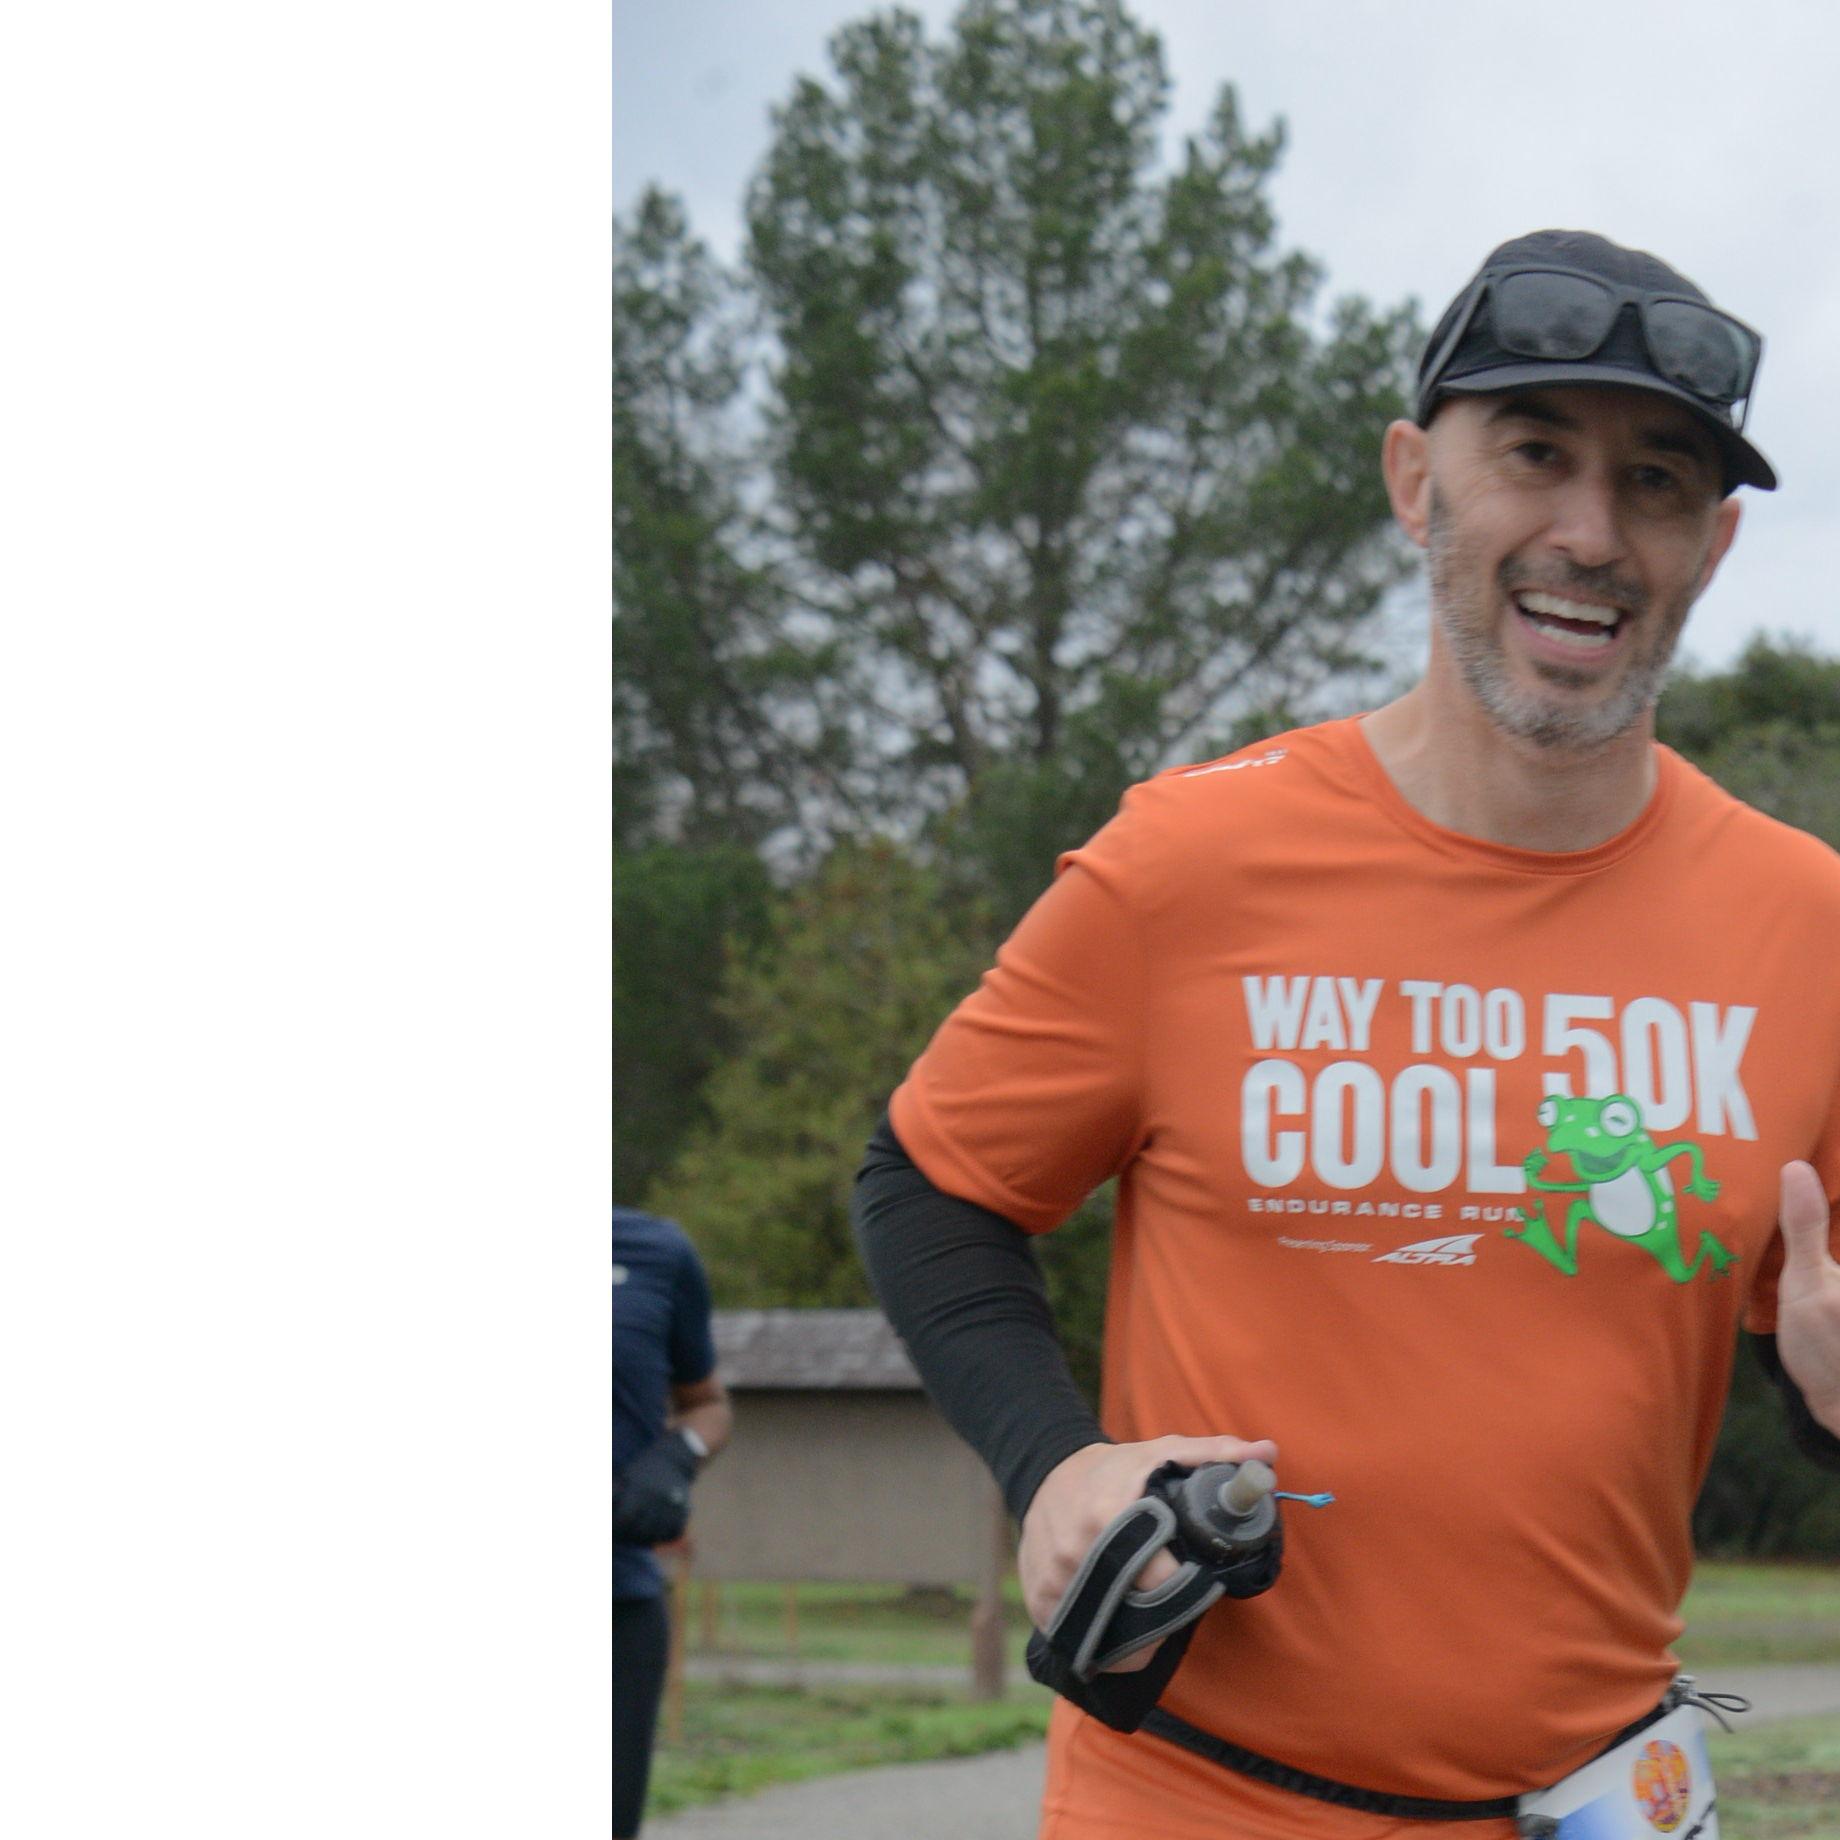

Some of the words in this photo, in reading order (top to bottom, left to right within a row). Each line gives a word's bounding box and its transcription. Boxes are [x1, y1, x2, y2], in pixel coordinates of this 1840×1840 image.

[1243, 976, 1384, 1052] WAY
[1400, 979, 1526, 1060] TOO
[1542, 992, 1759, 1141] 50K
[1241, 1059, 1527, 1194] COOL
[1248, 1198, 1443, 1220] ENDURANCE
[1460, 1205, 1526, 1222] RUN
